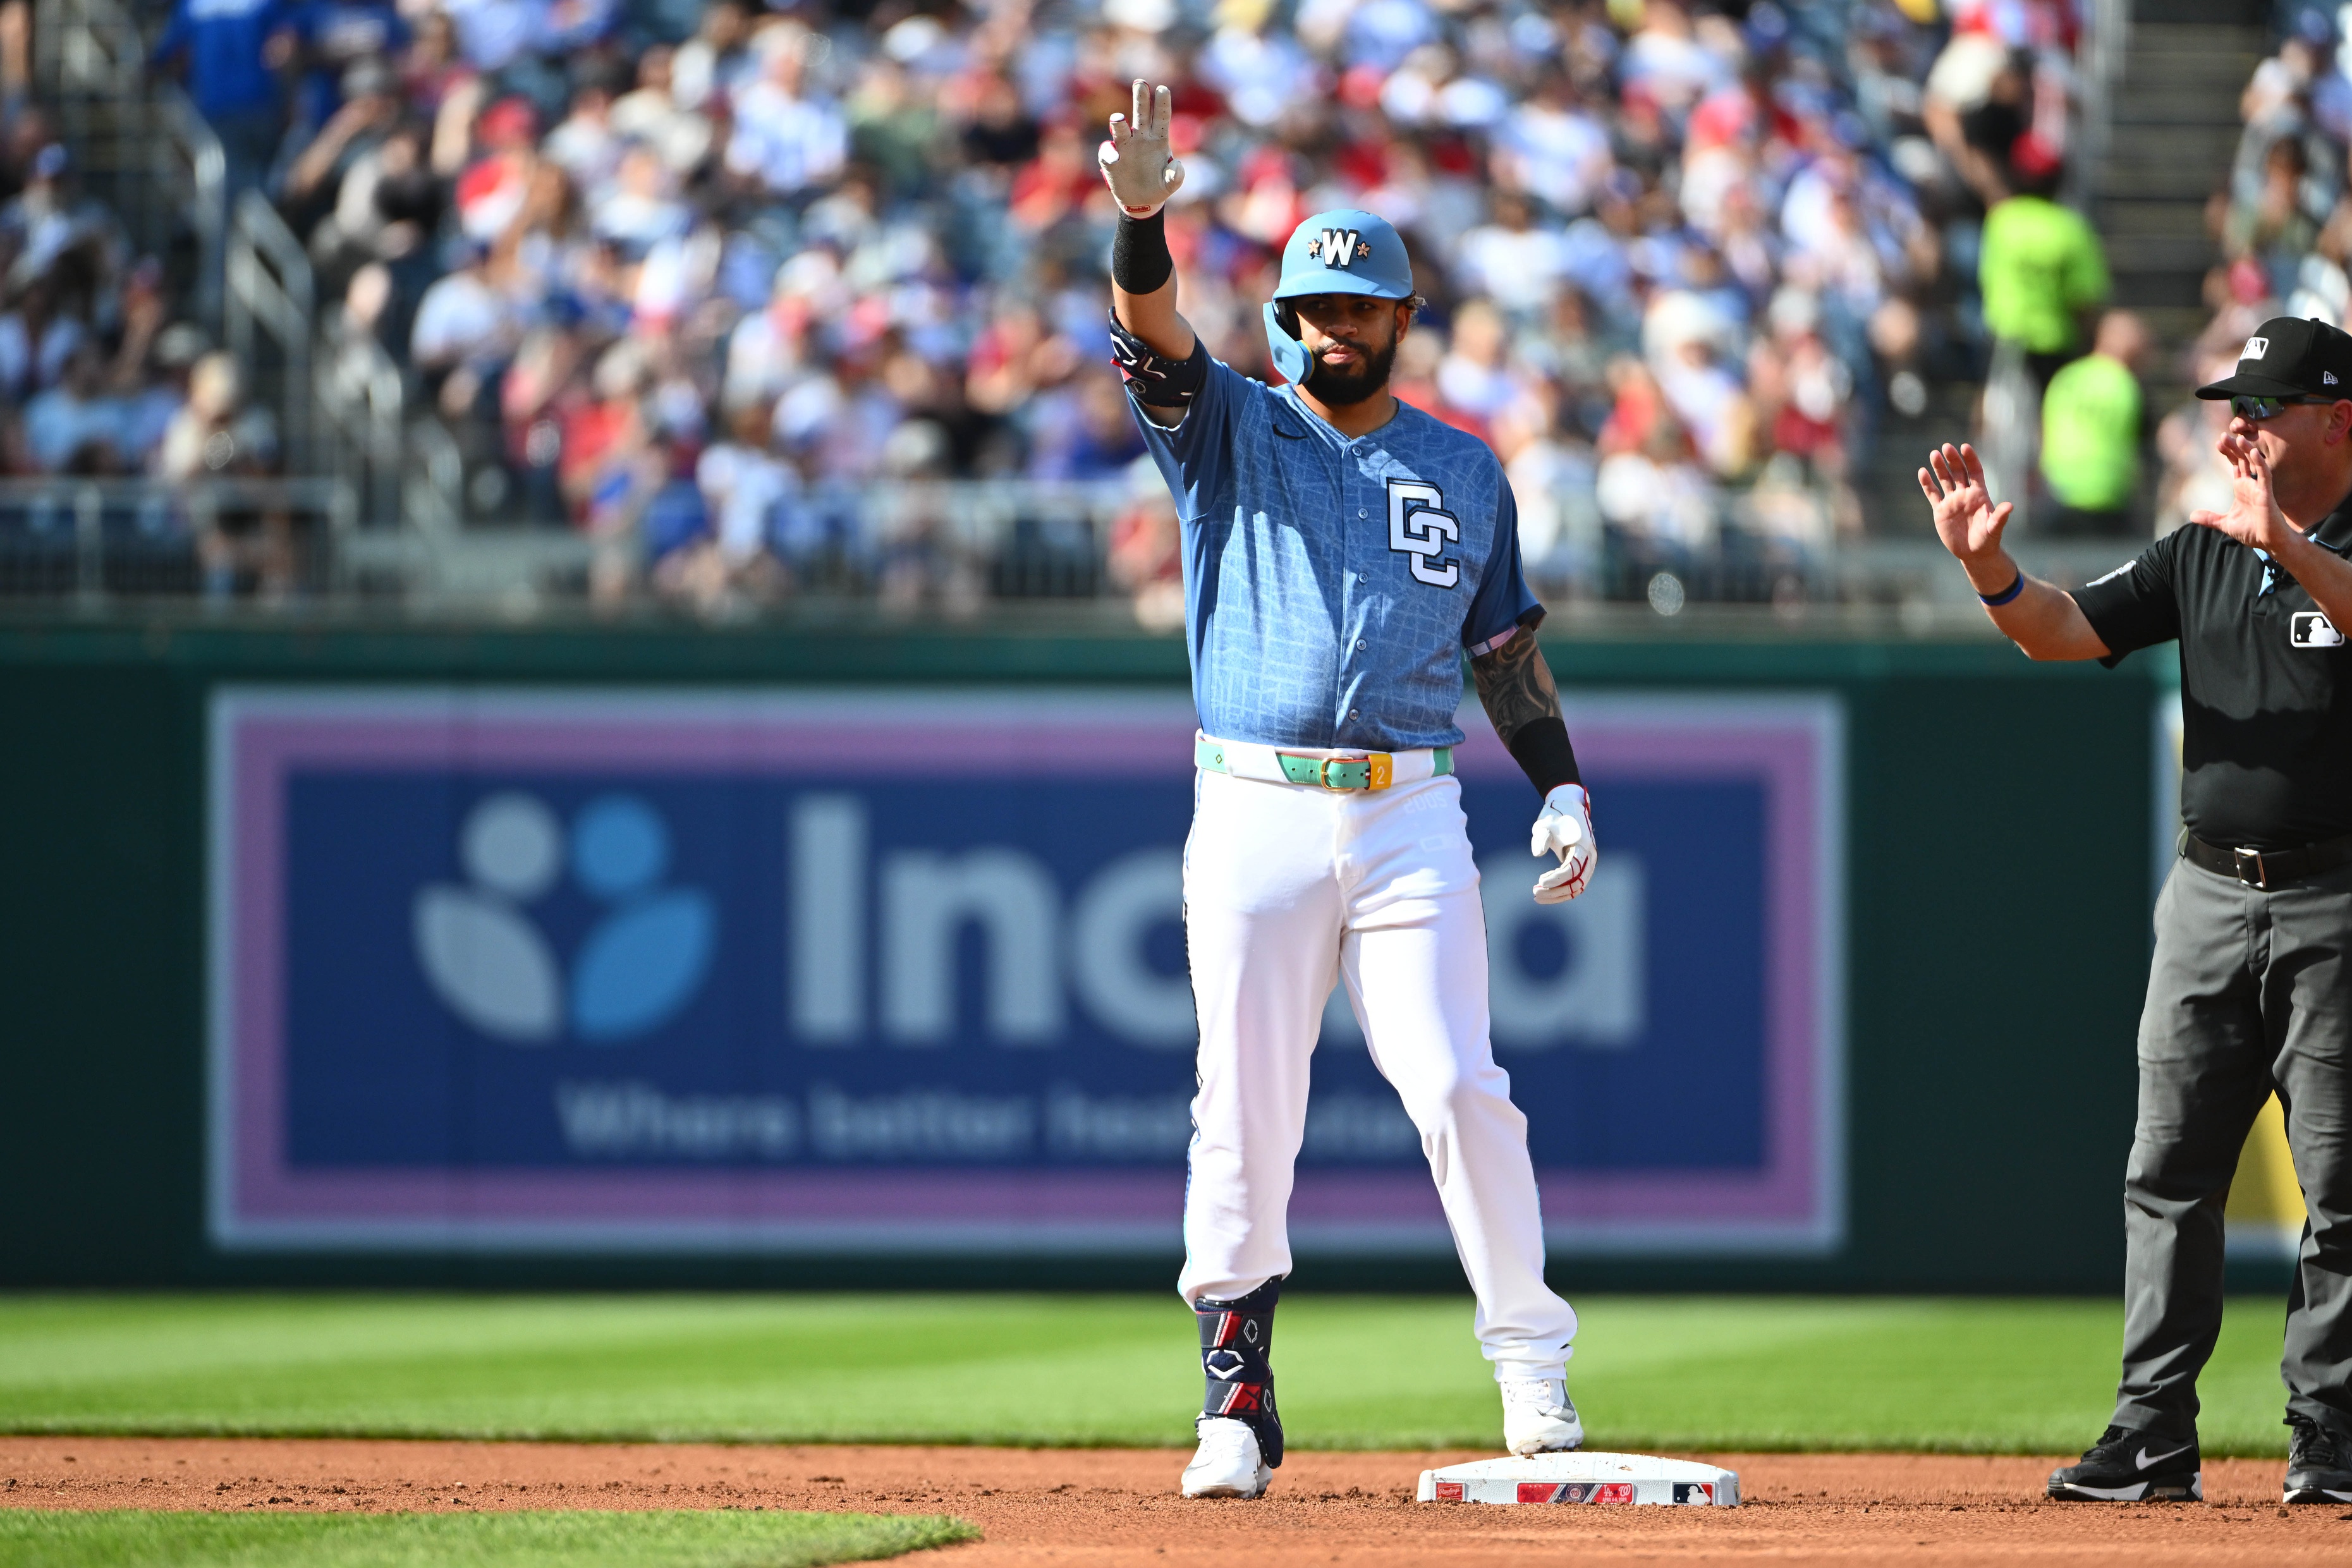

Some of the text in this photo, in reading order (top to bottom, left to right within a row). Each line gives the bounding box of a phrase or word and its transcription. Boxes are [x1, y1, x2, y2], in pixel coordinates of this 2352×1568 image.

[1322, 228, 1358, 267] W
[1386, 477, 1459, 589] DC
[1376, 765, 1385, 785] 2
[1403, 790, 1448, 814] 2005
[789, 794, 1647, 1049] Inoa
[1438, 1487, 1461, 1496] Rawlings
[1618, 1484, 1631, 1497] W
